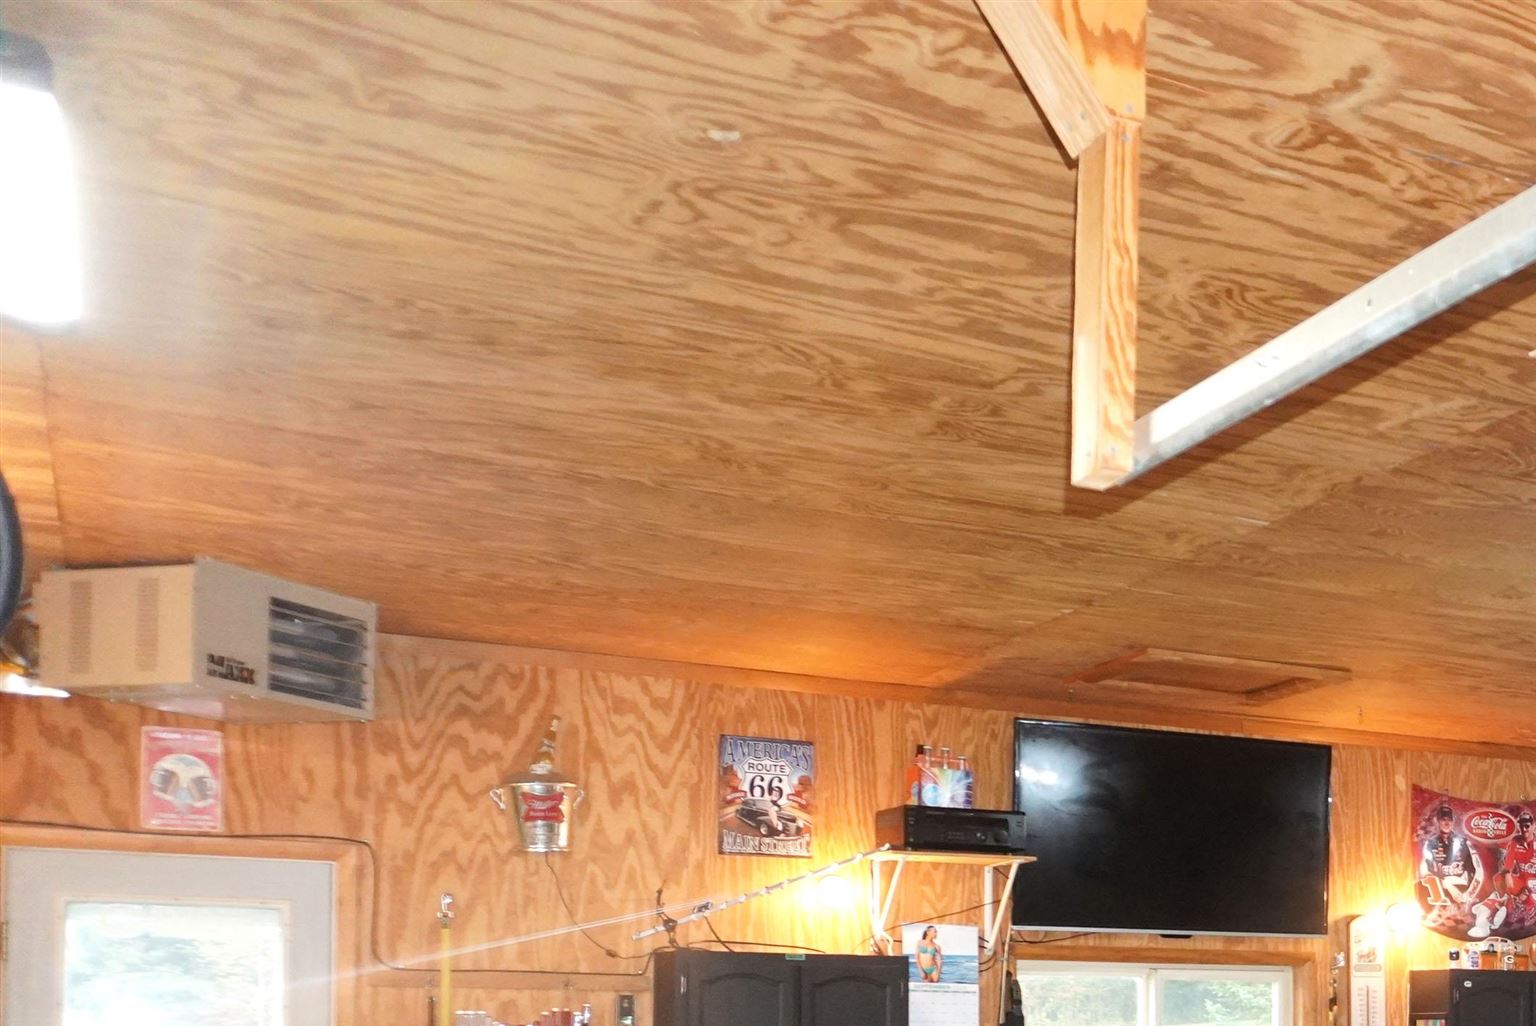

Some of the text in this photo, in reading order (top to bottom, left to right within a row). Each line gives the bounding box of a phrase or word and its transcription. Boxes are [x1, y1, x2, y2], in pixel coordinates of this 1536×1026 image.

[748, 762, 786, 773] ROUTE
[750, 775, 784, 802] 66
[722, 829, 758, 852] MAIN
